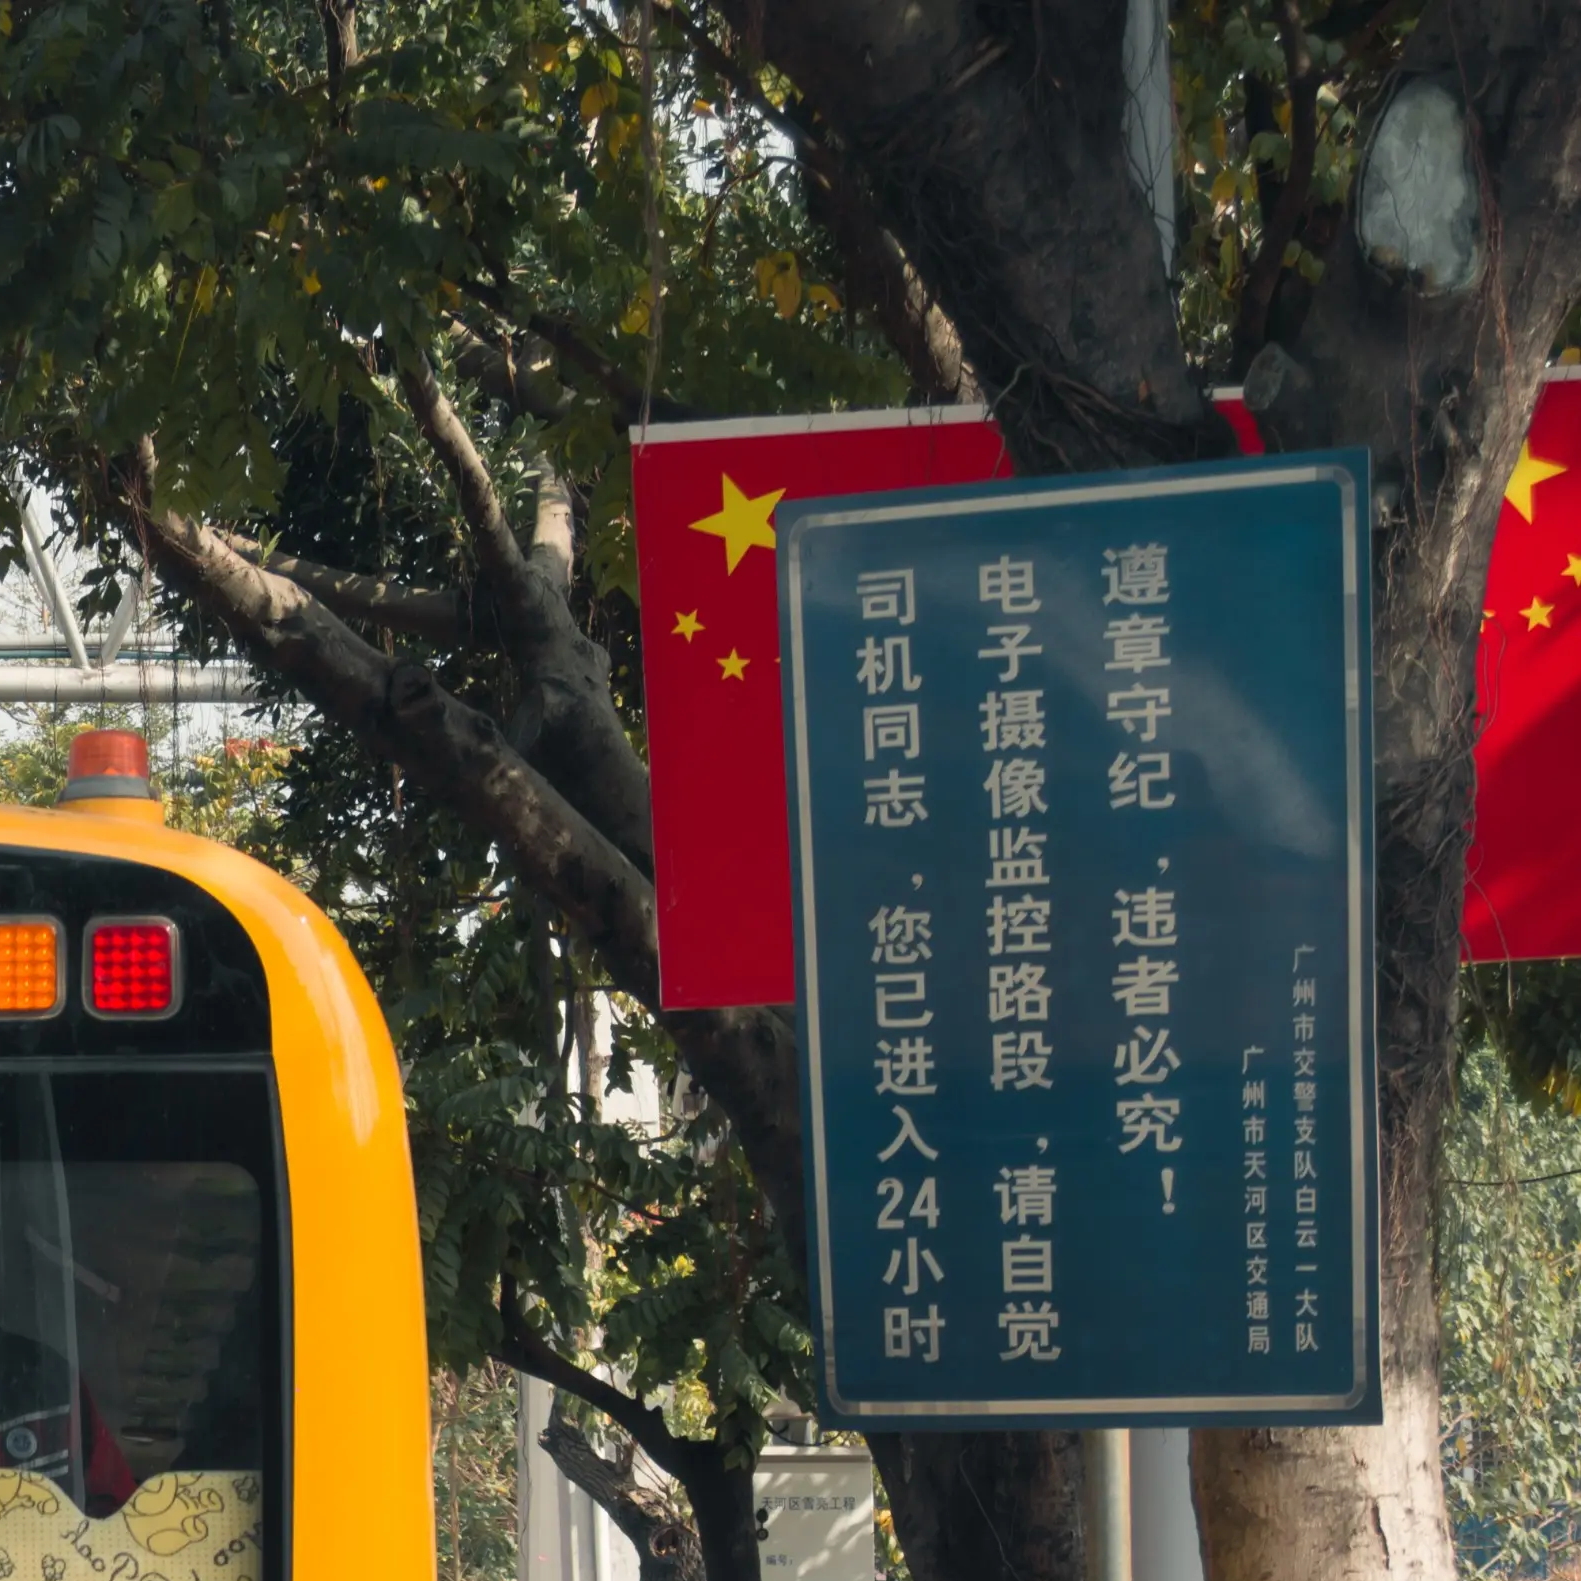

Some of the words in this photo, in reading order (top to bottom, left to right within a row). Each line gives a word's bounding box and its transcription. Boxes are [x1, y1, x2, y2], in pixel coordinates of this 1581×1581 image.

[1241, 1045, 1270, 1355] 广州市天河区交通局
[1292, 944, 1318, 1352] 广州市交警支队白云一大队
[761, 1496, 856, 1511] 天河区雪亮工程
